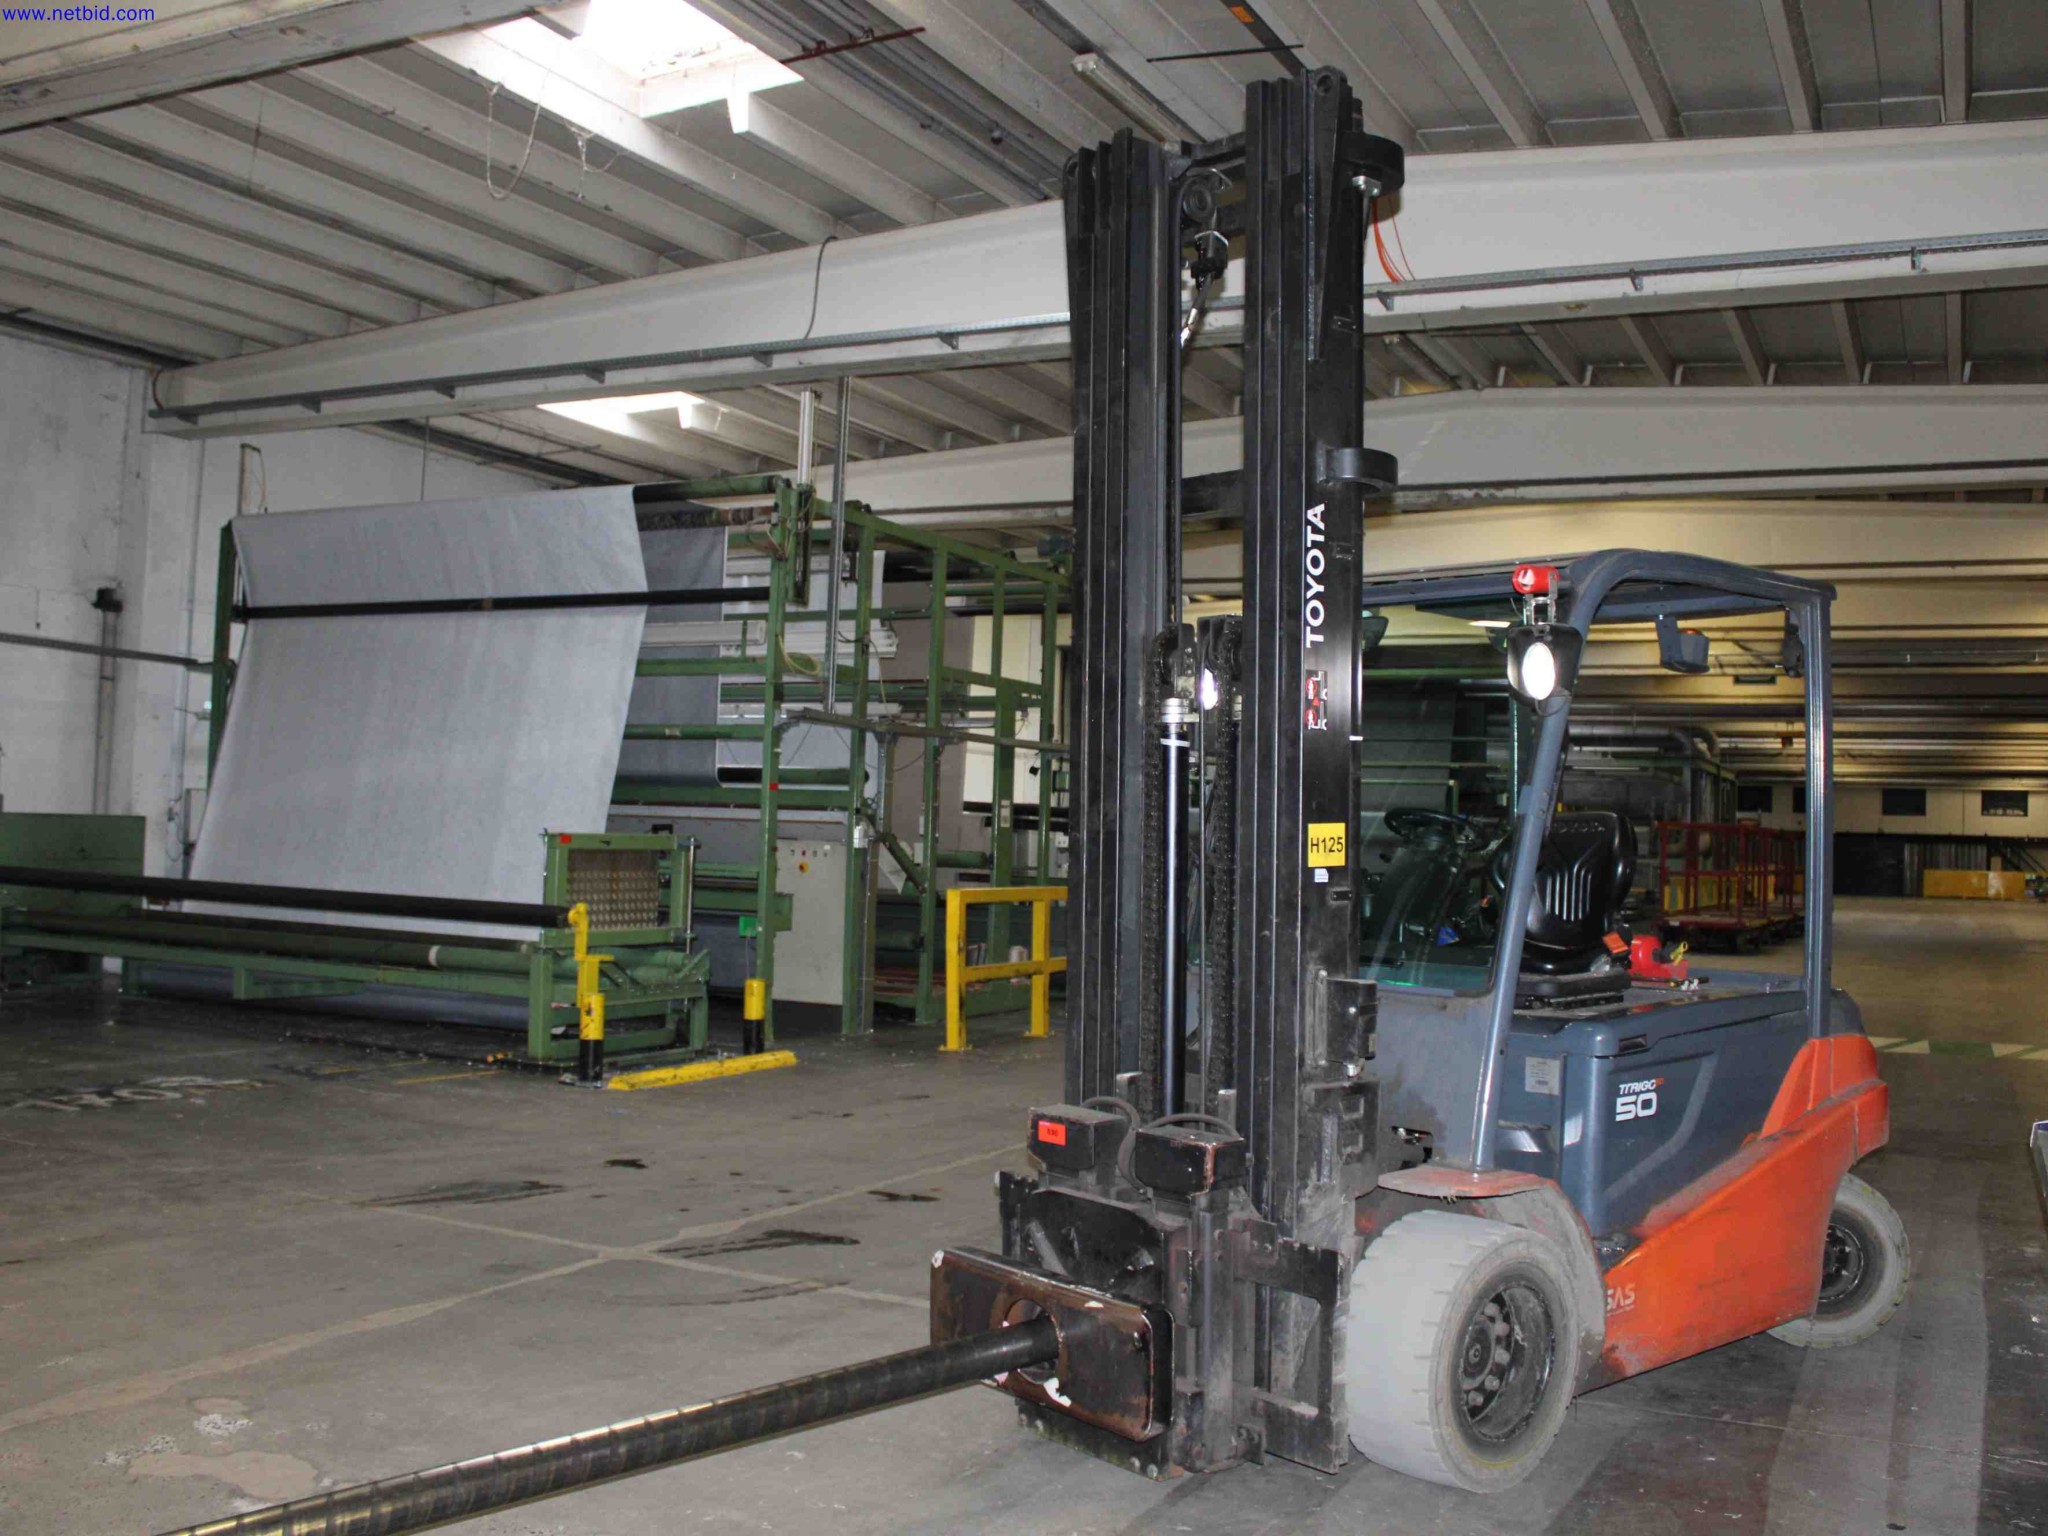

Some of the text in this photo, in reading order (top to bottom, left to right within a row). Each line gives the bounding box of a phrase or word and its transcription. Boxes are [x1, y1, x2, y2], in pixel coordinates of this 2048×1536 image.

[1306, 503, 1325, 648] TOYOTA
[1310, 836, 1344, 853] H125
[1615, 1091, 1657, 1121] 50
